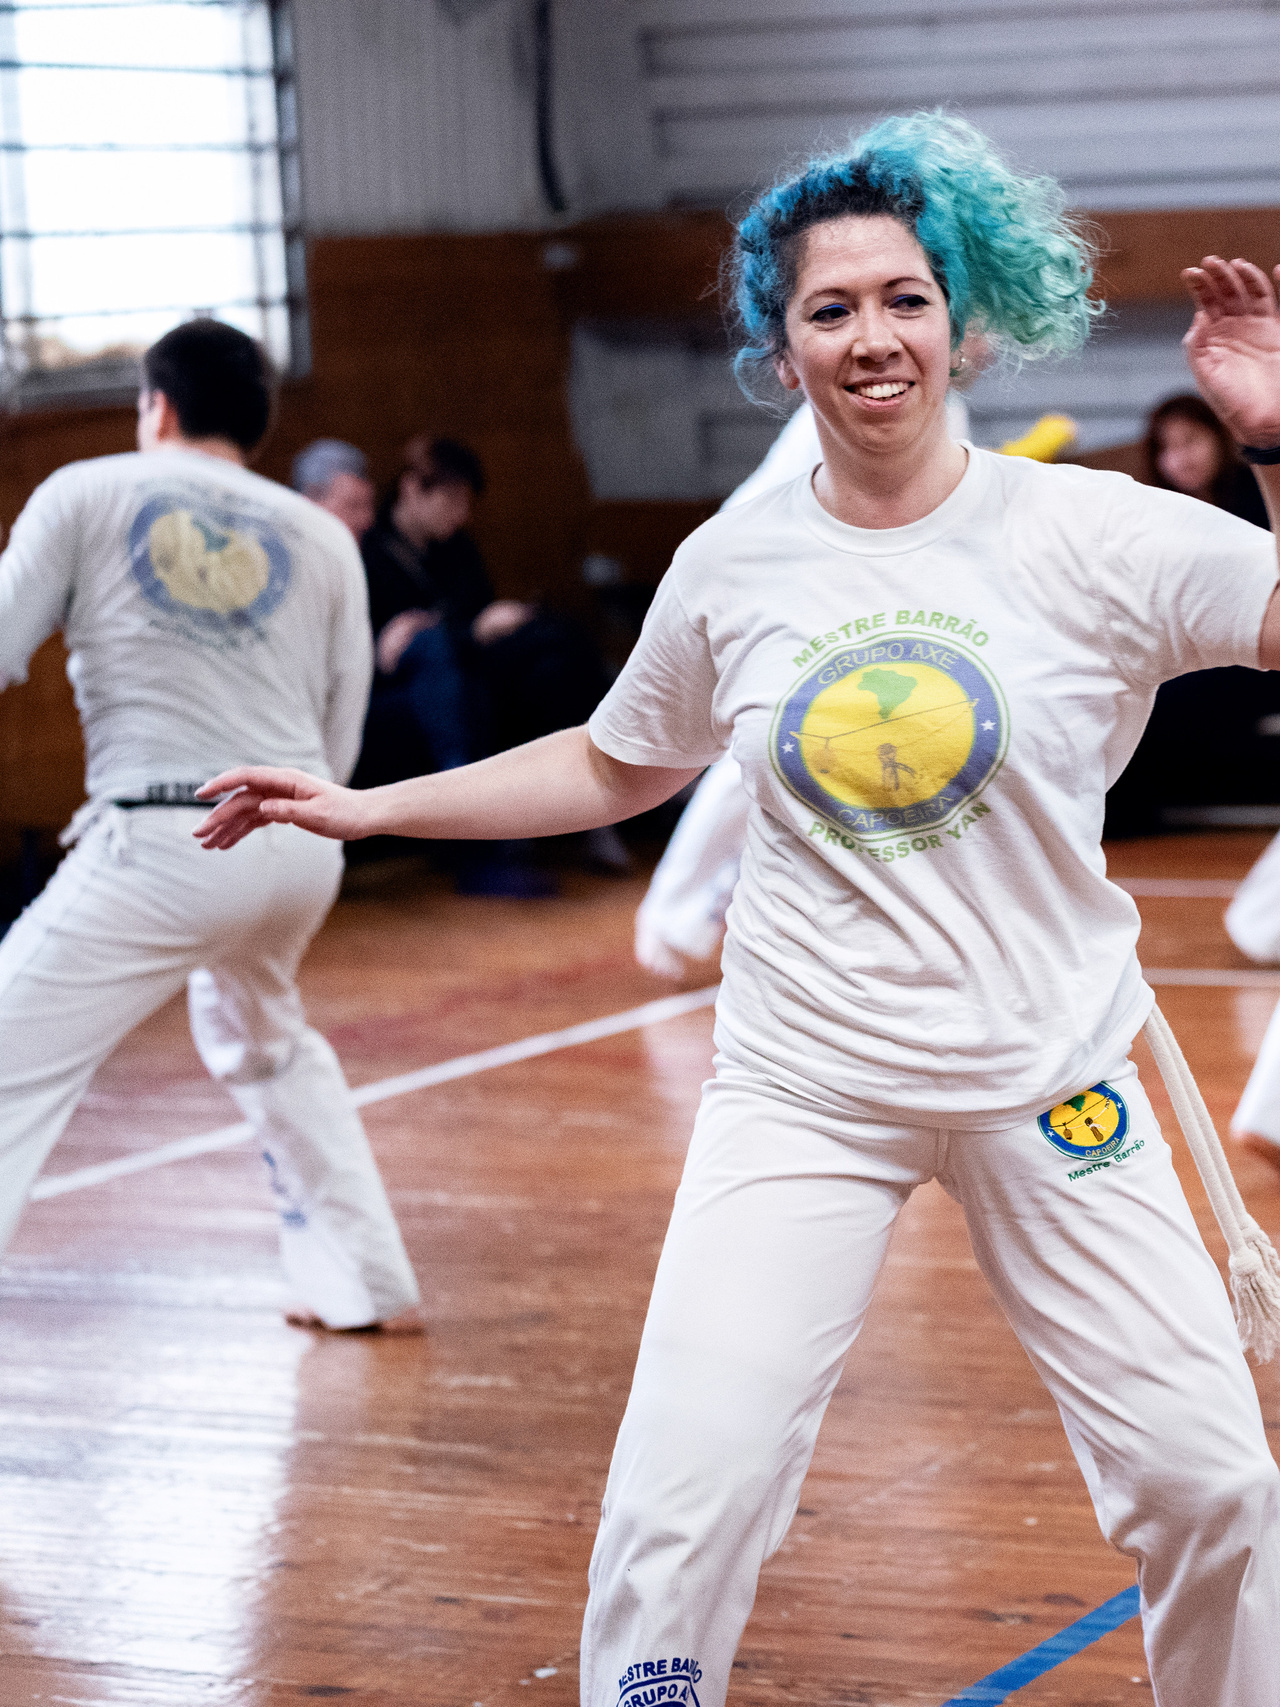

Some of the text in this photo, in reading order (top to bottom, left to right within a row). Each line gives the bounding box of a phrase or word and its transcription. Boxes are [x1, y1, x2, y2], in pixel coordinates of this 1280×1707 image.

[792, 609, 990, 669] MESTRE BARRÃO
[817, 642, 960, 686] GRUPO AXÉ
[837, 795, 955, 830] CAPOEIRA
[945, 801, 992, 841] YAN
[1067, 1139, 1145, 1182] Mestre Barrão
[1085, 1136, 1121, 1158] CAPOEIRA
